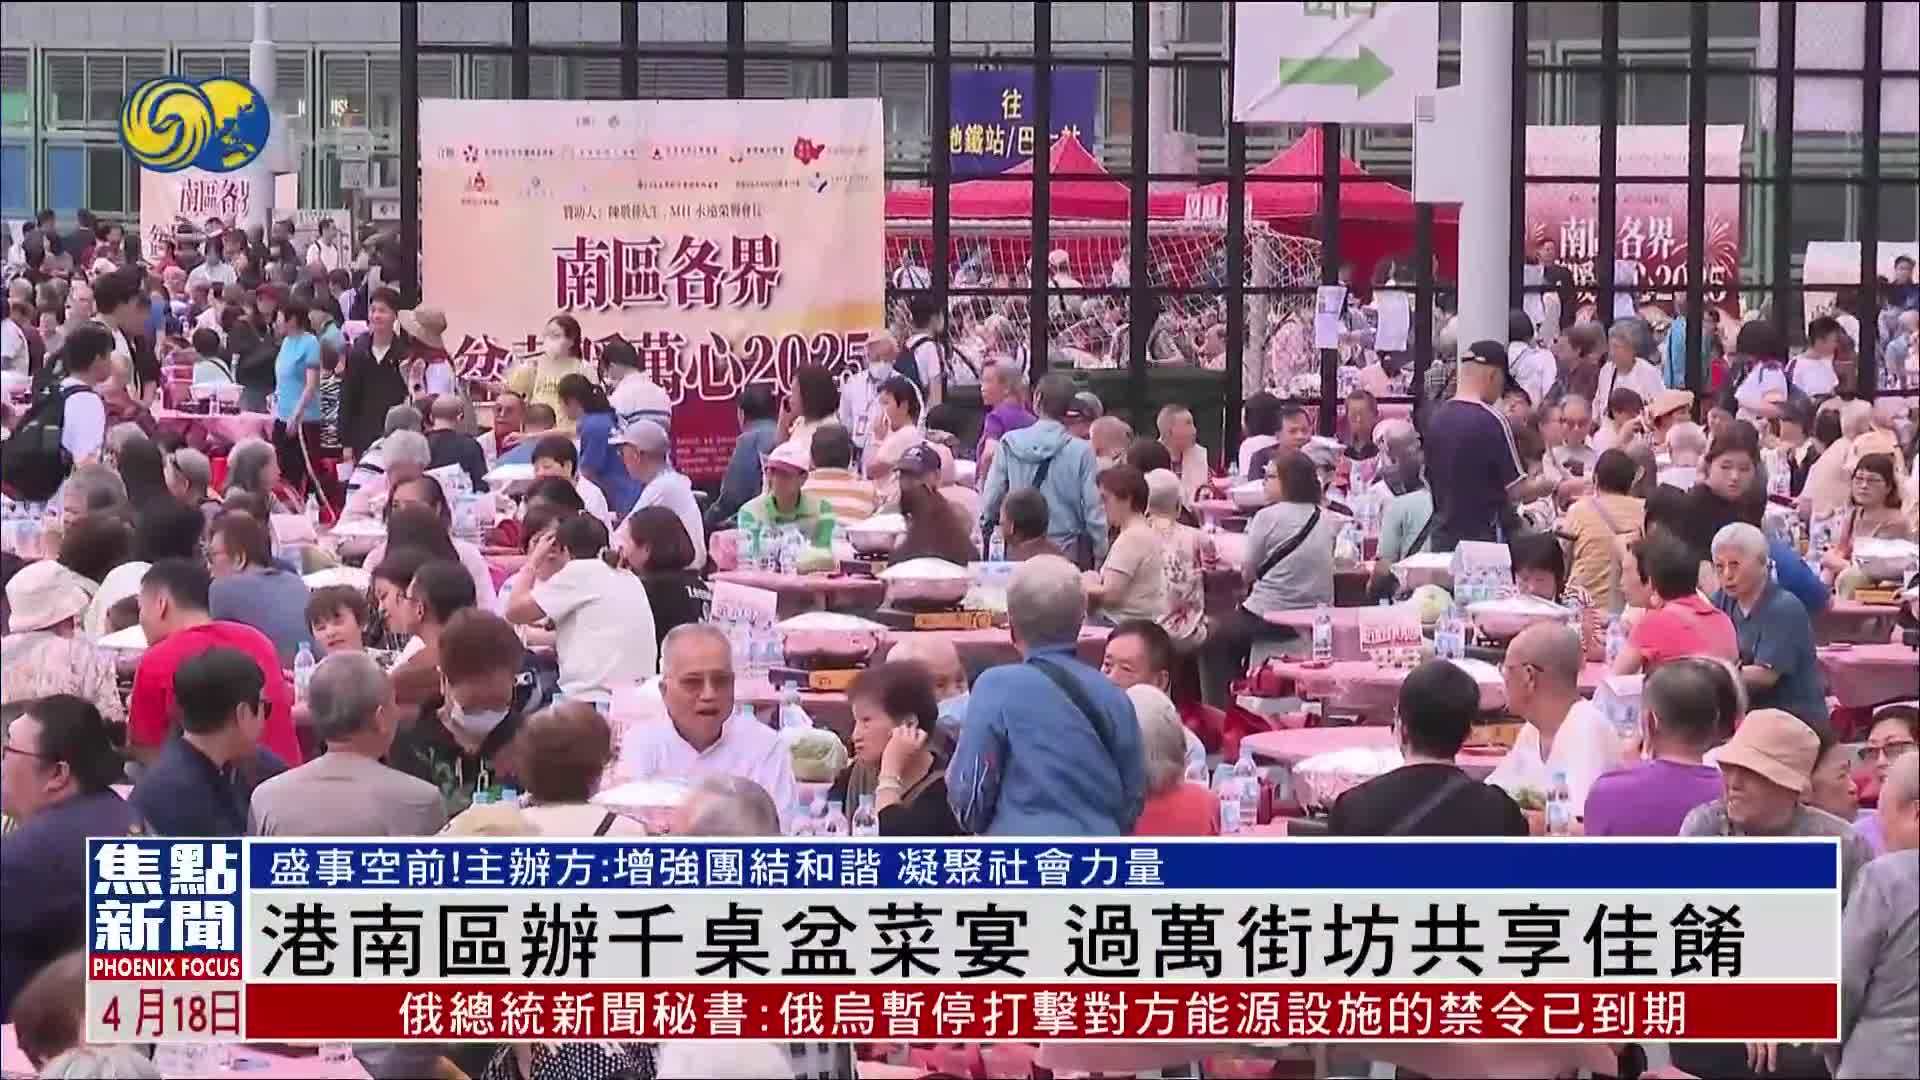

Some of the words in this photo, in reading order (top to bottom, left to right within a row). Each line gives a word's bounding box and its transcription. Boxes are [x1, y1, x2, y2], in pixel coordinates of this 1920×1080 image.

[1001, 88, 1022, 120] 往
[553, 234, 782, 308] 南區各界
